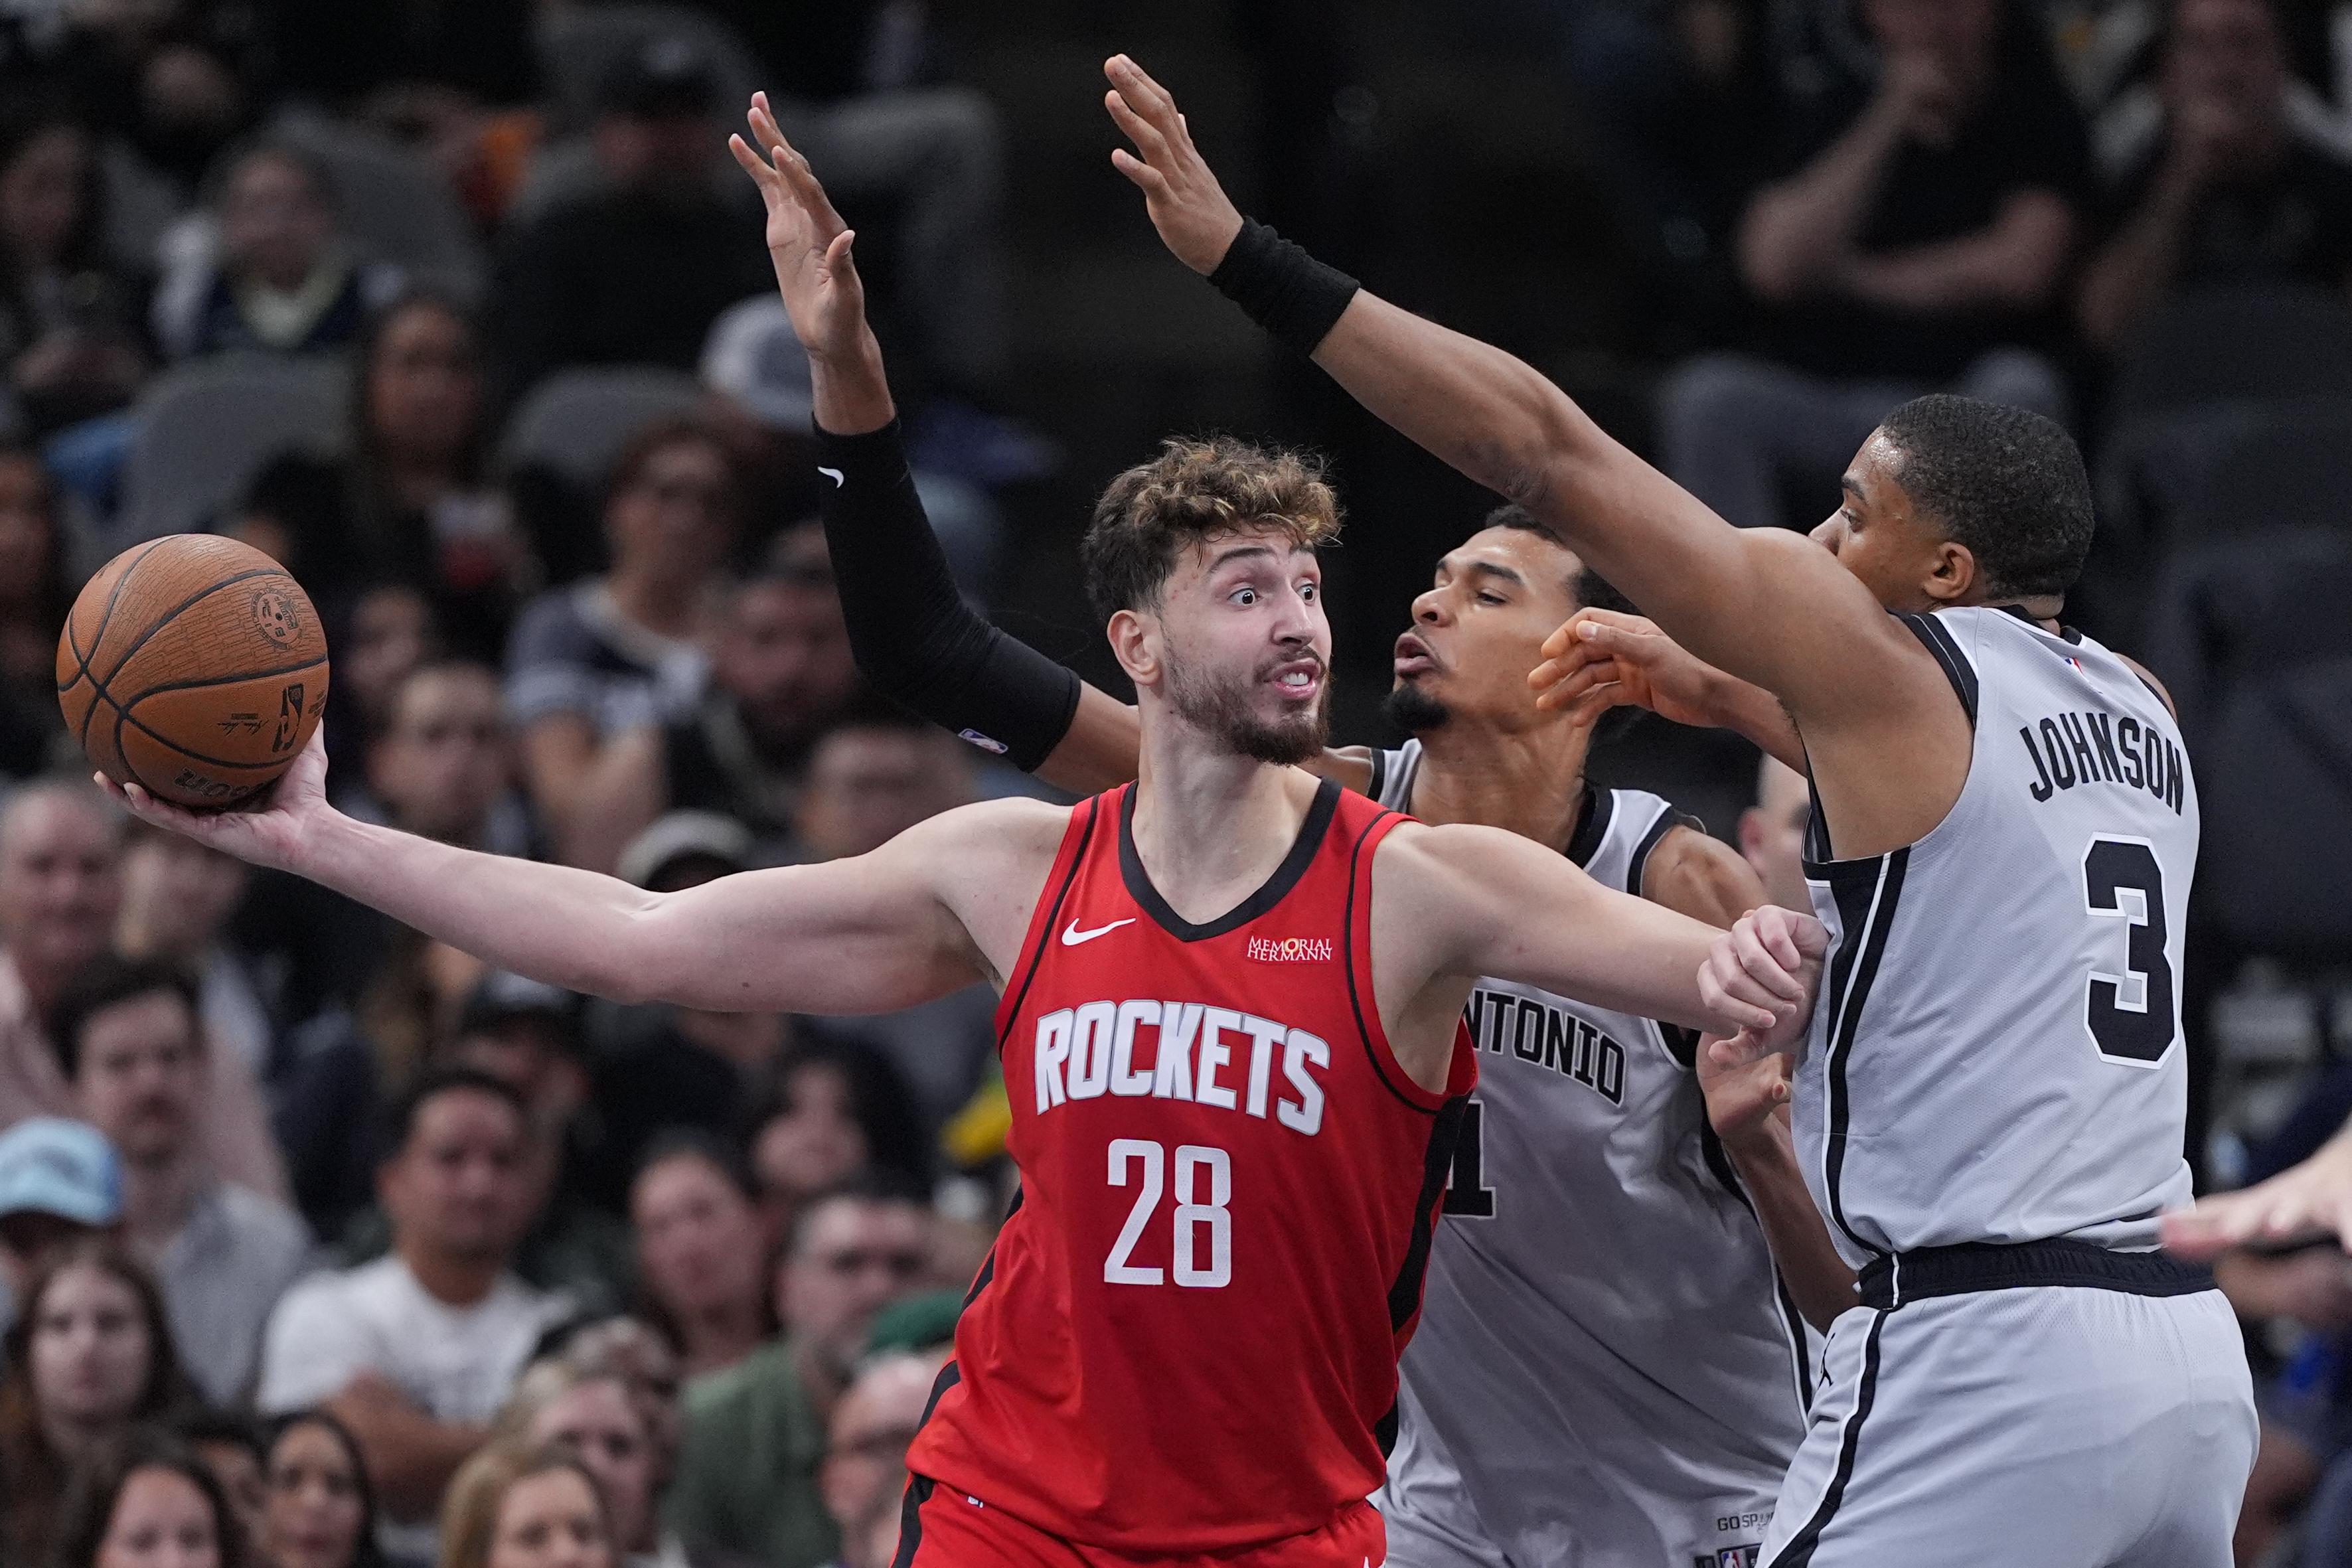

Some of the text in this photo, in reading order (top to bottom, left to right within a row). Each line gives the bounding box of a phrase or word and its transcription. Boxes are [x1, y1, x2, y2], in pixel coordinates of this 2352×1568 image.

[2019, 712, 2184, 816] JOHNSON
[1247, 935, 1333, 953] MEMORIAL
[1247, 946, 1332, 962] HERMANN
[2080, 831, 2180, 1070] 3
[1035, 999, 1330, 1137] ROCKETS
[1462, 988, 1626, 1109] NTONIO
[1103, 1138, 1232, 1289] 28
[1717, 1515, 1741, 1531] GO
